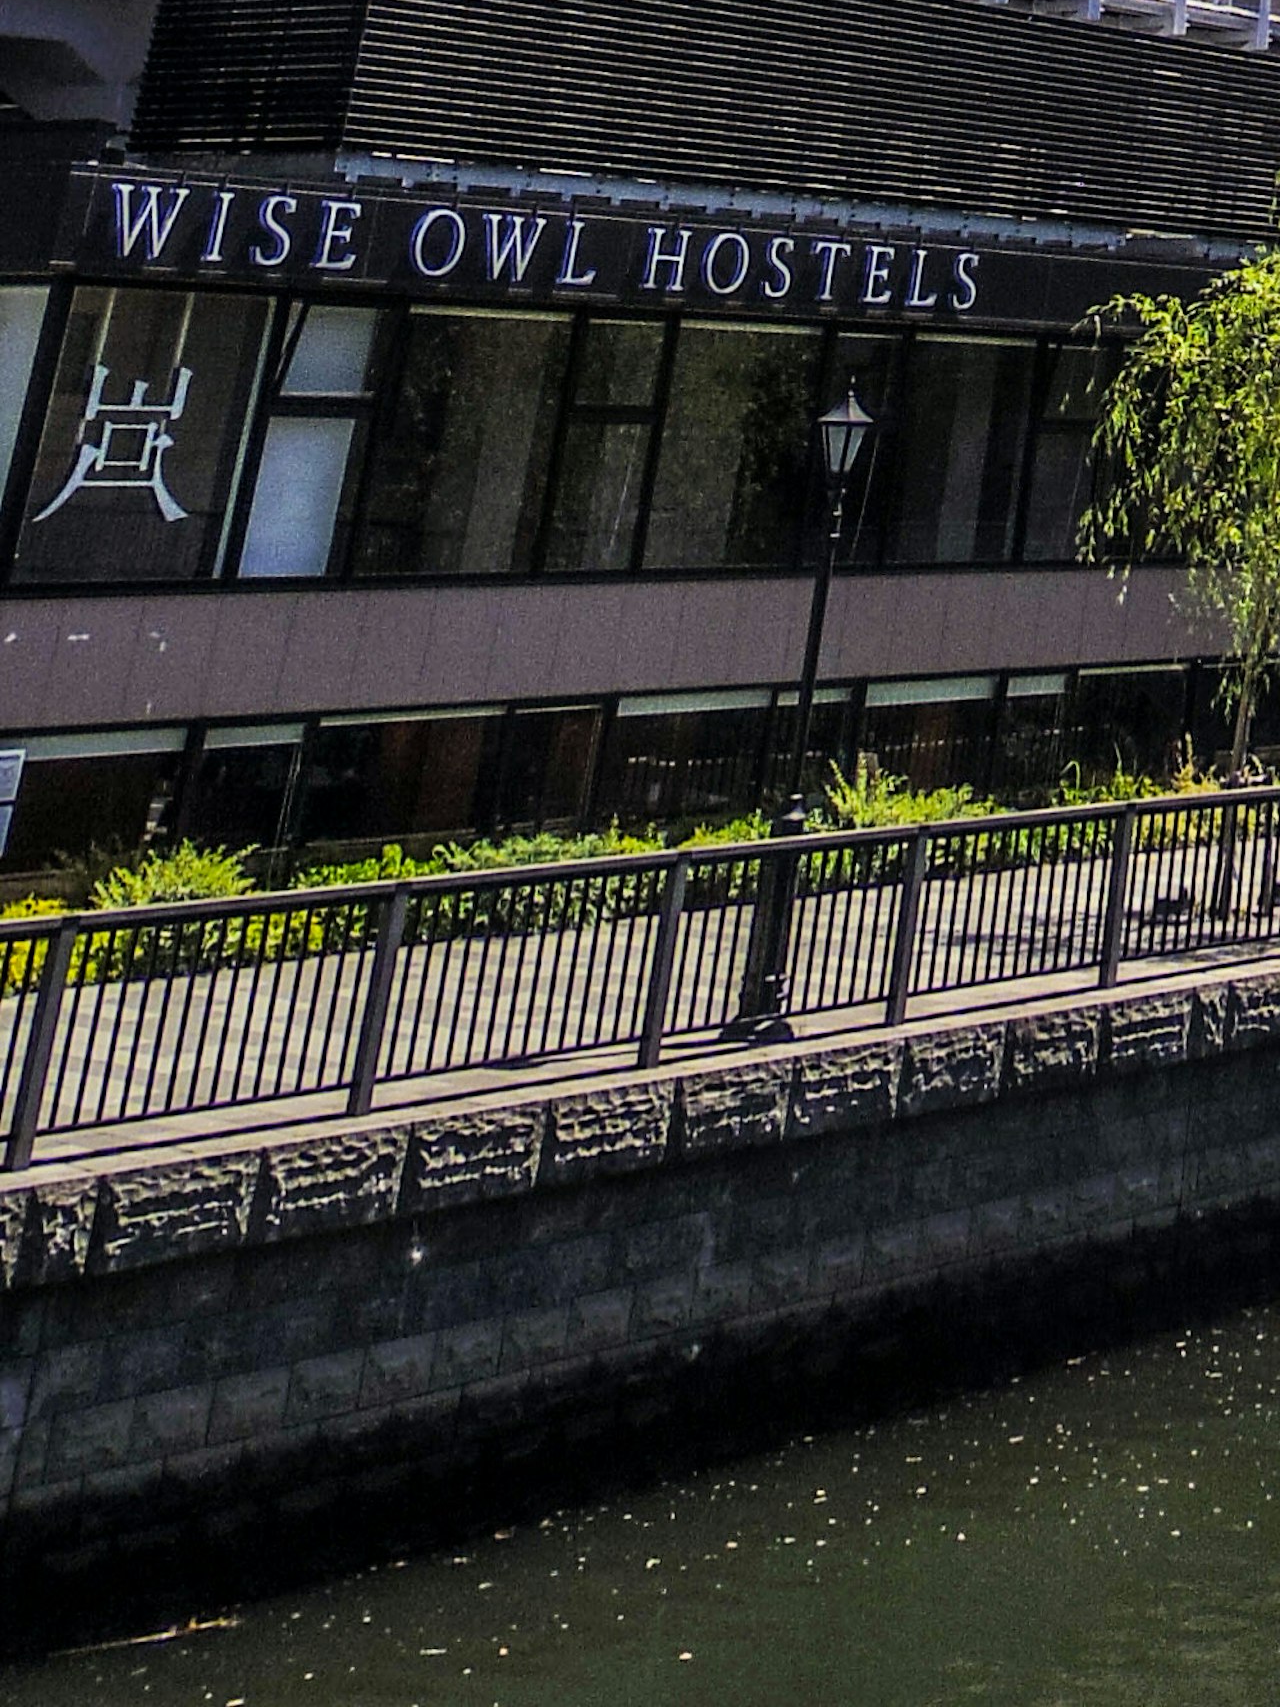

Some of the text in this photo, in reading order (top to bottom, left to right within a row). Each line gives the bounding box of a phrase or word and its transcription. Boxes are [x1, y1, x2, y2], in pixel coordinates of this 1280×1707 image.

[112, 183, 980, 311] WISE OWL HOSTELS
